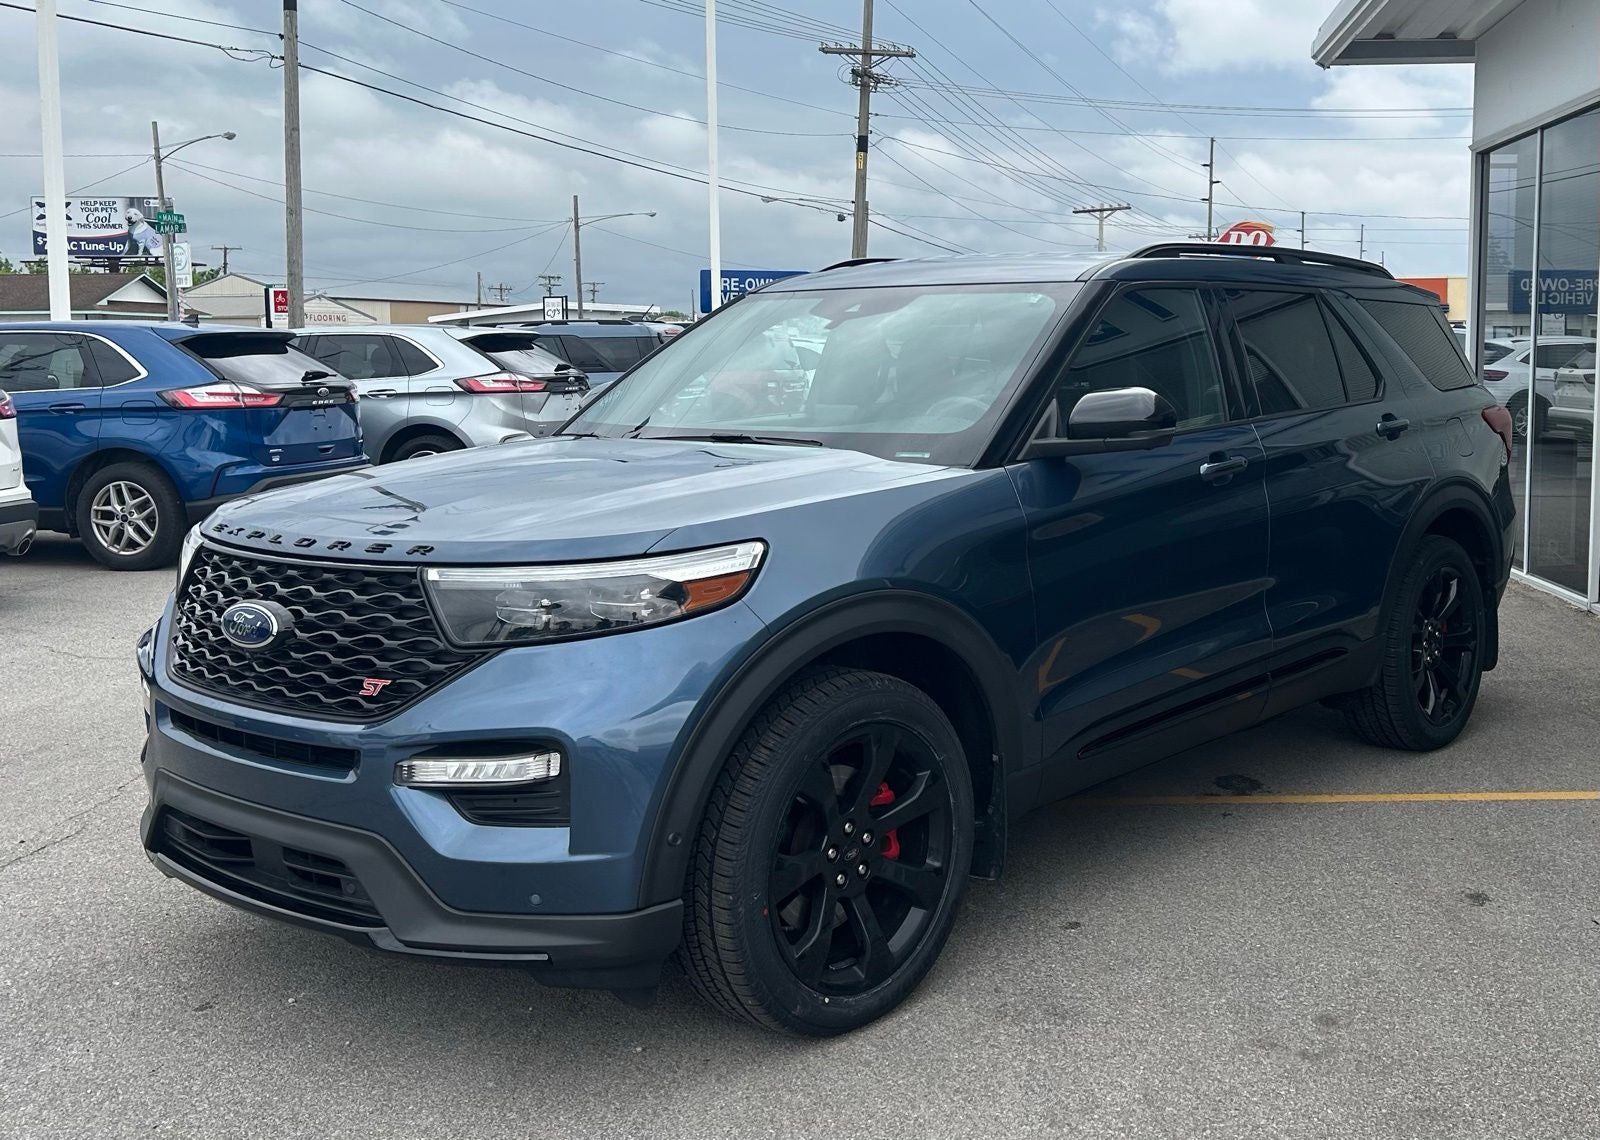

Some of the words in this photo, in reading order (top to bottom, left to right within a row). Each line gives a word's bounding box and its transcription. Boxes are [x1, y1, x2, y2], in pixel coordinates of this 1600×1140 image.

[85, 213, 111, 223] Cool
[162, 213, 178, 222] MAIN
[155, 224, 179, 234] LAMAR
[80, 242, 123, 252] Tune-Up
[309, 314, 347, 322] FLOORING
[212, 523, 435, 556] EXPLORER
[359, 678, 392, 696] ST
